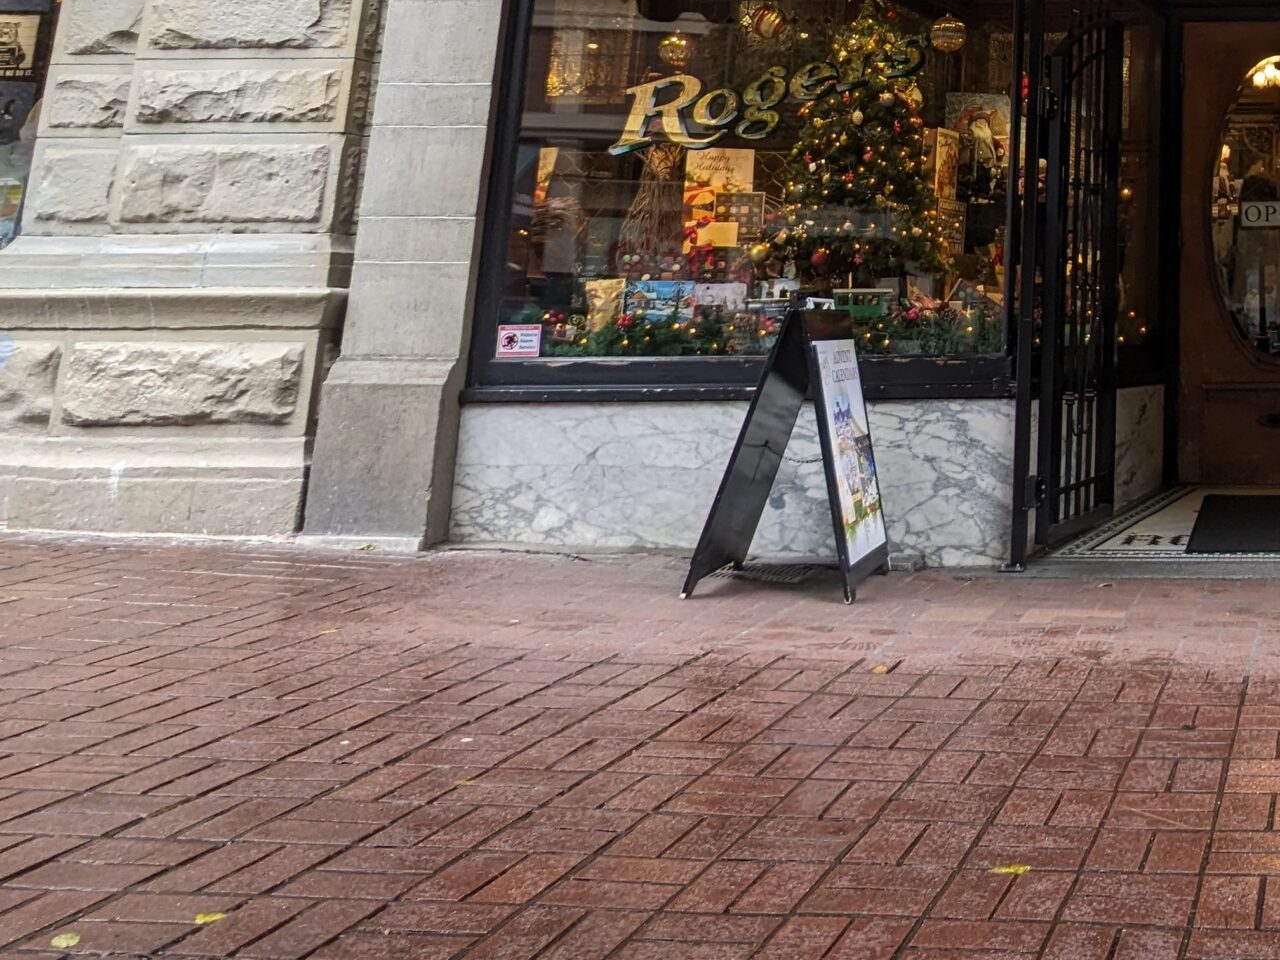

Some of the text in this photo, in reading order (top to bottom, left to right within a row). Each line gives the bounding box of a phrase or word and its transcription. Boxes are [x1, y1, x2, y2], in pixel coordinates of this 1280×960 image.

[607, 37, 927, 158] Rogers
[697, 151, 730, 162] Happy
[691, 161, 735, 174] Holidays
[832, 366, 859, 383] CALENDARS
